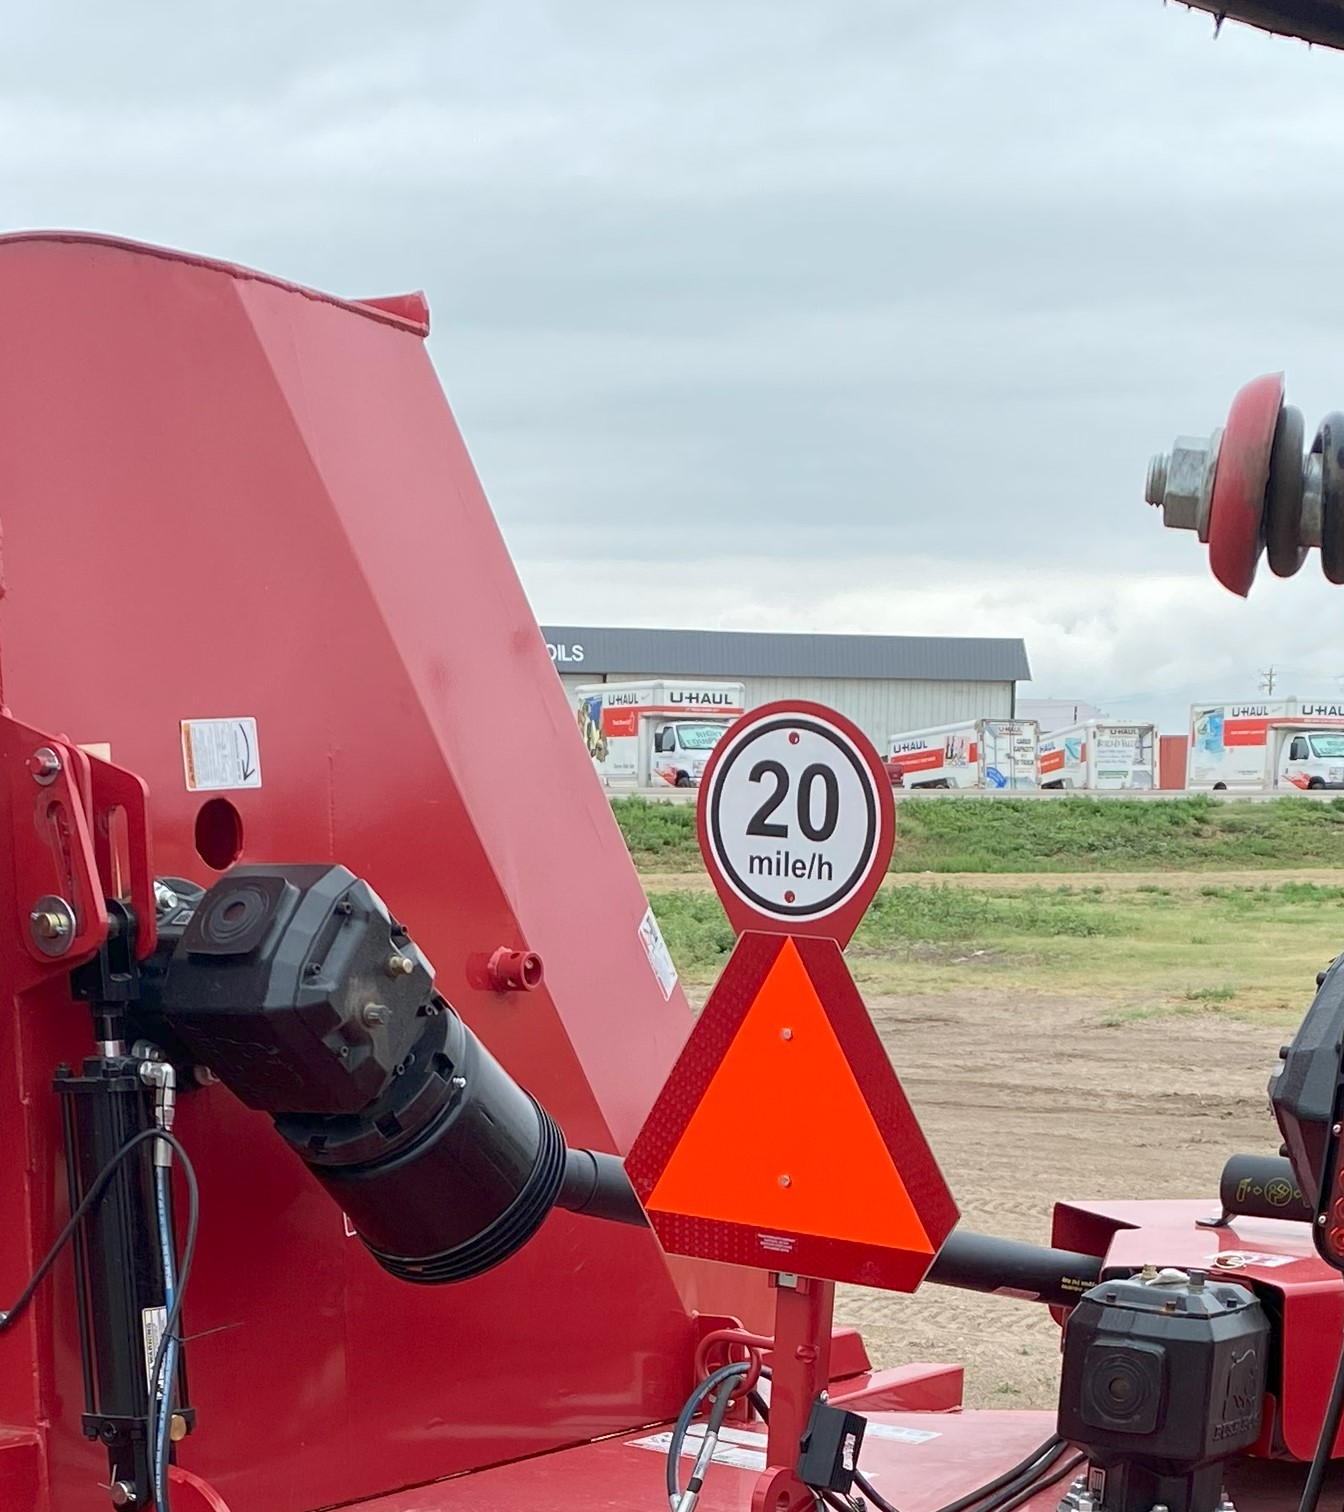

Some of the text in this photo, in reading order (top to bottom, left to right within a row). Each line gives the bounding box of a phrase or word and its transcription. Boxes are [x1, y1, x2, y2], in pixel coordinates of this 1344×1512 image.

[608, 692, 639, 706] U-HAUL
[669, 691, 733, 705] U-HAUL
[1232, 705, 1269, 718] U-HAUL
[893, 740, 929, 754] U-HAUL
[746, 759, 840, 843] 20
[749, 850, 833, 881] mile/h
